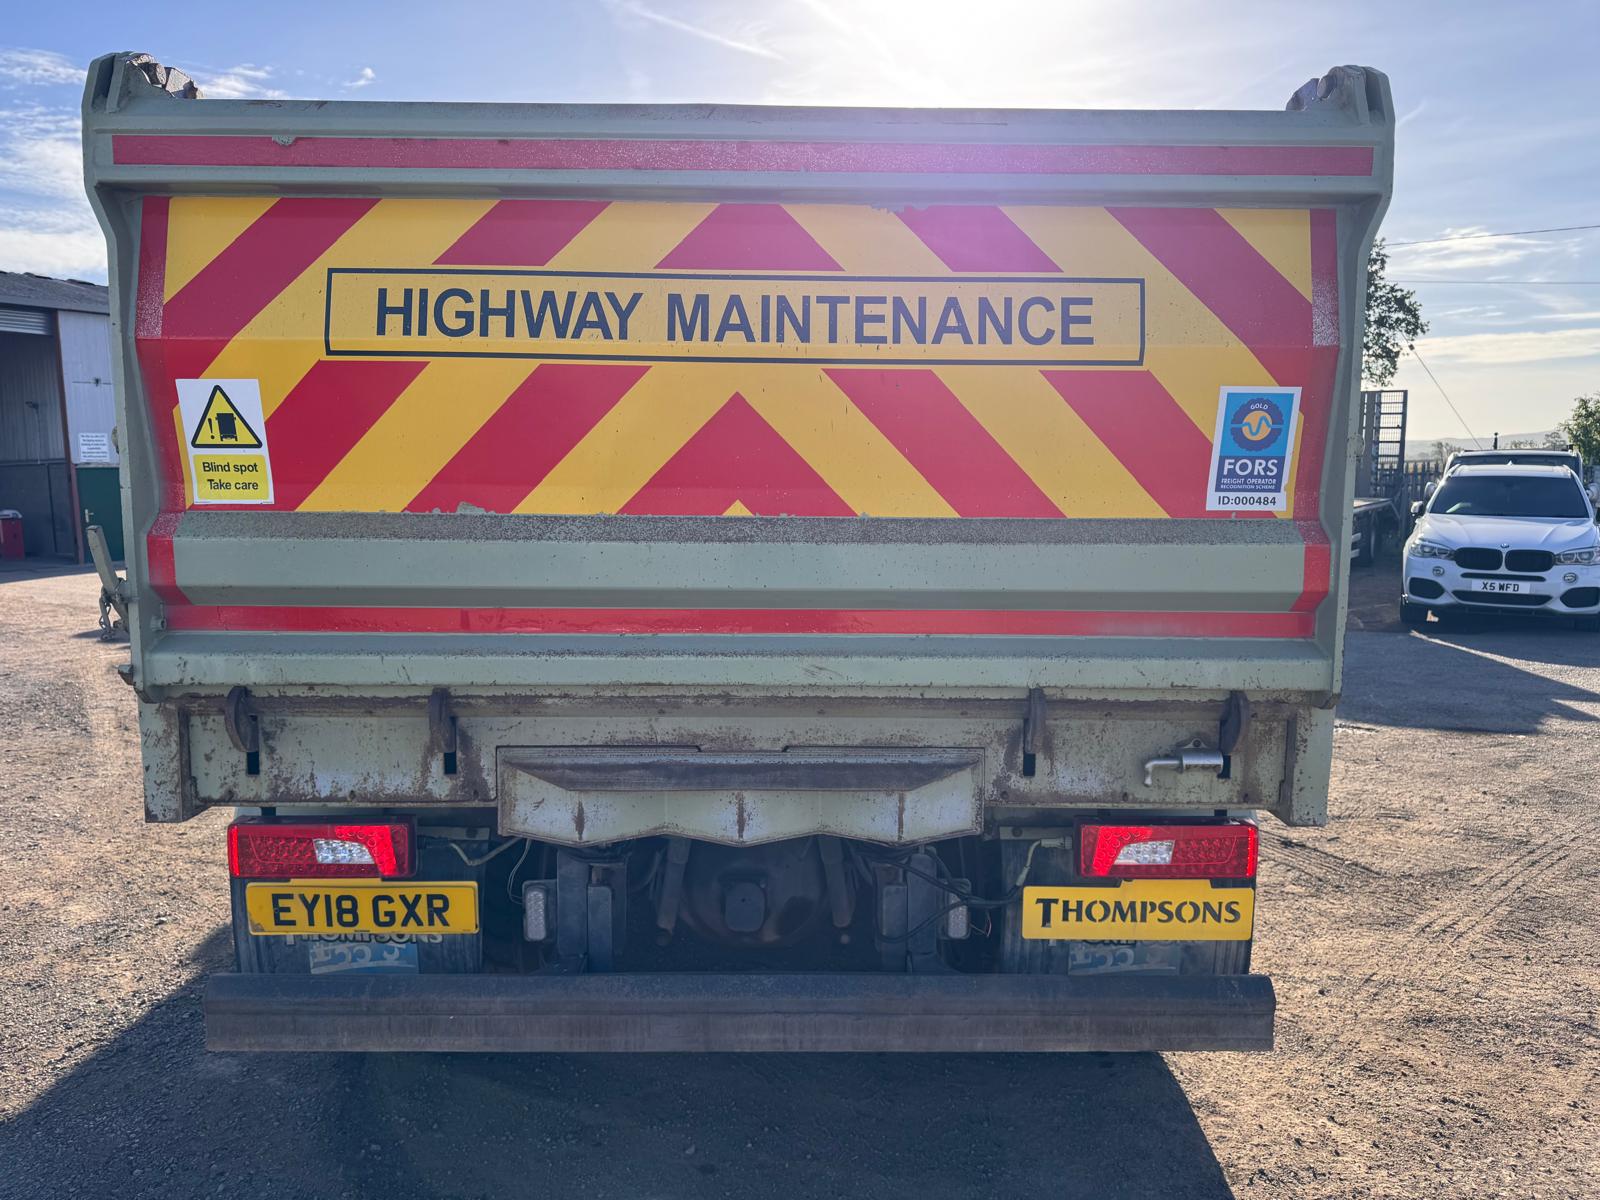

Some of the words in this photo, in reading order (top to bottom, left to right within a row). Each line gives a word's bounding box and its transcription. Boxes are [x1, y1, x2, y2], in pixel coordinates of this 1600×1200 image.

[376, 287, 643, 341] HIGHWAY
[666, 293, 1094, 346] MAINTENANCE
[1250, 402, 1269, 410] GOLD
[202, 461, 231, 472] Blind
[233, 462, 258, 475] spot
[1223, 459, 1278, 476] FORS
[207, 478, 231, 490] Take
[234, 482, 259, 490] care
[1218, 495, 1277, 506] ID:000484
[1481, 581, 1496, 591] X5
[1498, 582, 1520, 592] WFD
[271, 893, 359, 928] EY18
[371, 893, 450, 927] GXR
[1035, 898, 1242, 928] THOMPSONS
